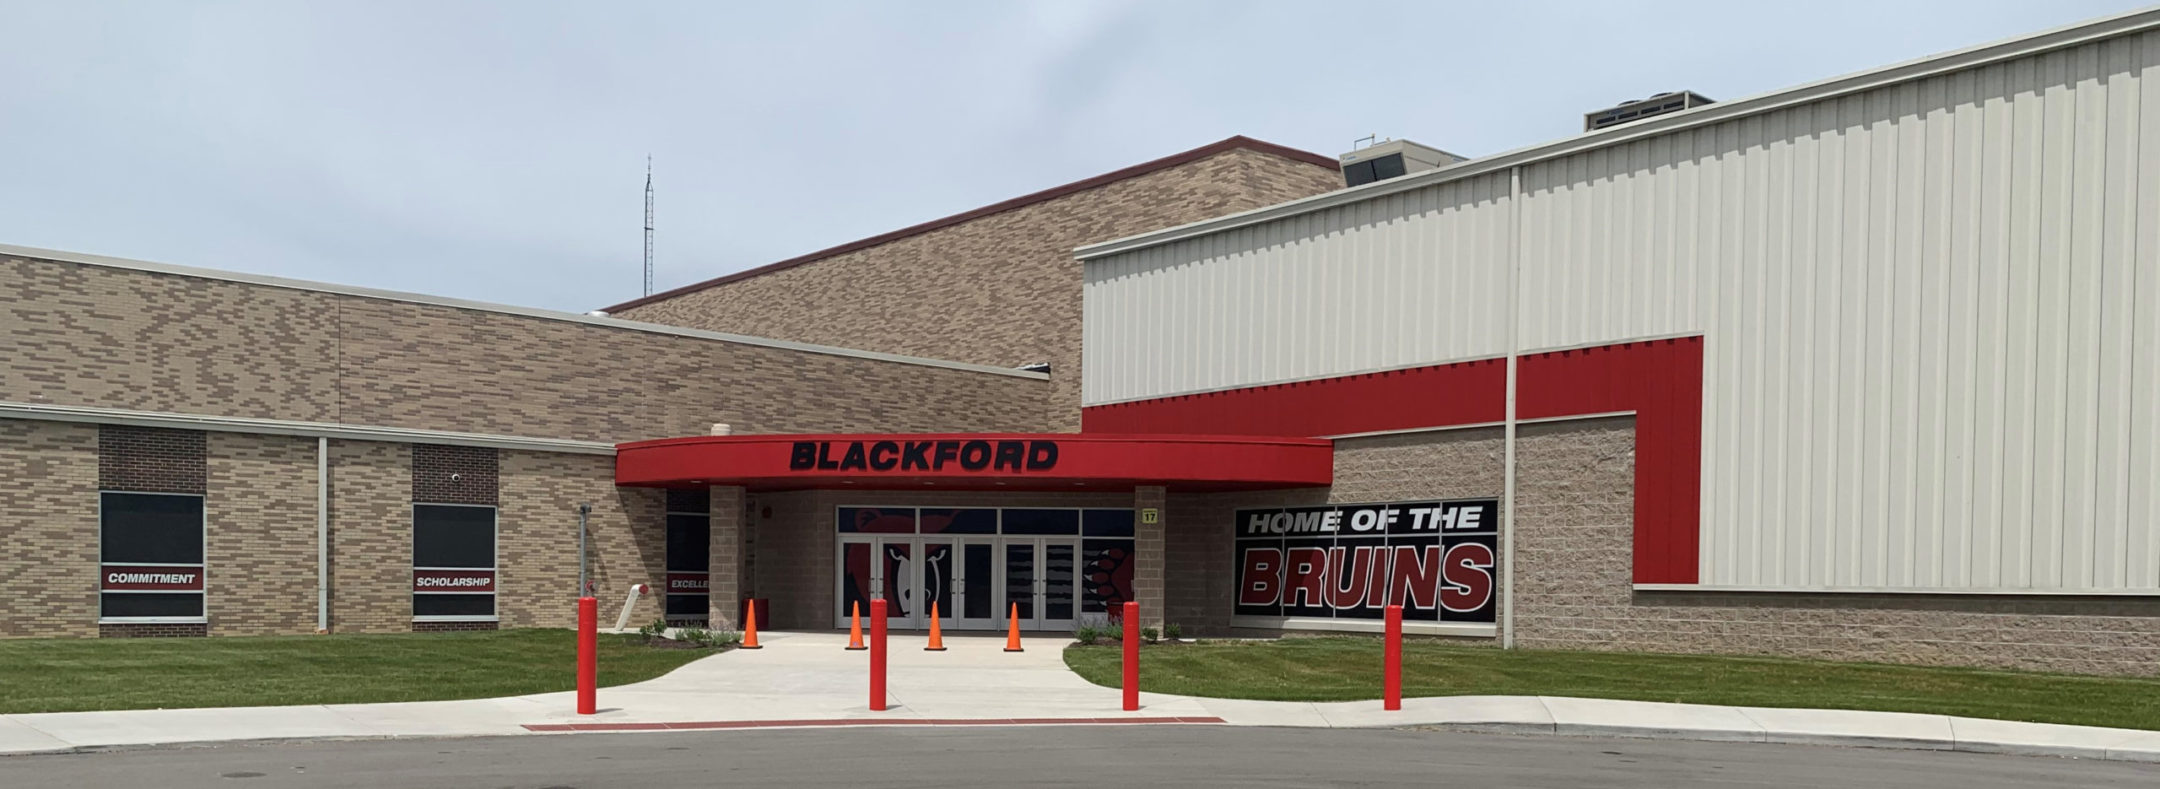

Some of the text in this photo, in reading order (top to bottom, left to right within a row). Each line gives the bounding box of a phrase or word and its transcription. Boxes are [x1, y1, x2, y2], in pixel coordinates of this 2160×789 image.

[790, 440, 1059, 472] BLACKFORD
[1144, 512, 1156, 521] 17
[1248, 506, 1483, 533] HOME OF THE
[108, 573, 195, 584] COMMITMENT
[416, 577, 491, 587] SCHOLARSHIP
[1239, 542, 1494, 612] BRUINS
[671, 580, 709, 588] EXCELLE
